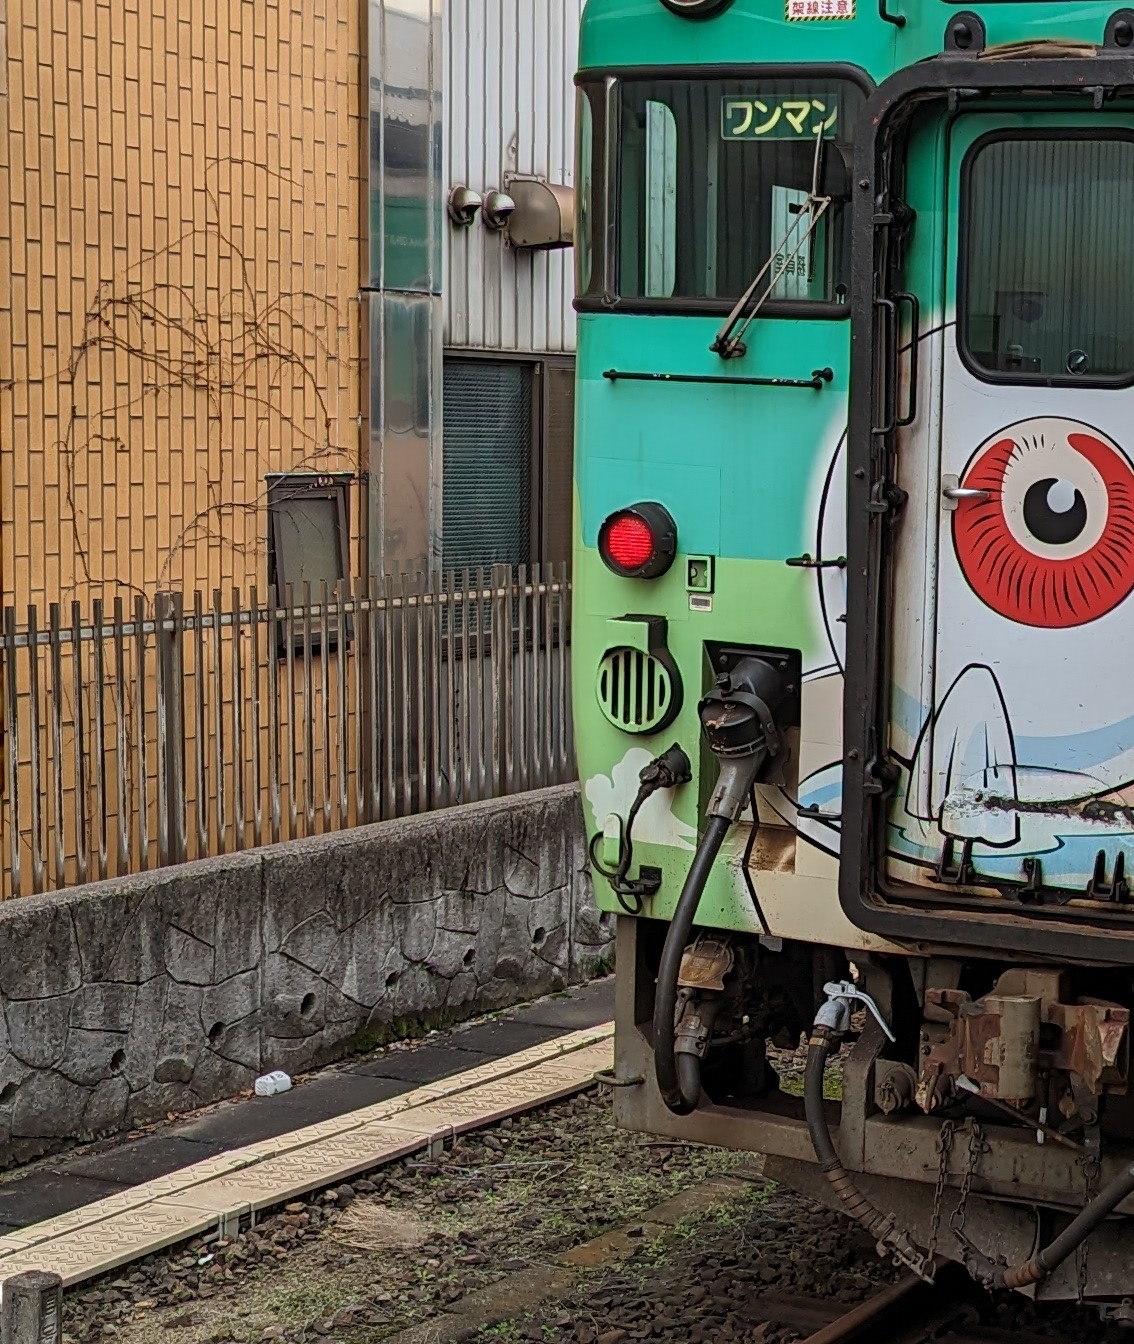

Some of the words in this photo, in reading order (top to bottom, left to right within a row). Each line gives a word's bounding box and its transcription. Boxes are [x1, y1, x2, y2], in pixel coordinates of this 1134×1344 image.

[792, 0, 849, 16] 架線注意
[726, 99, 838, 135] ワンマン
